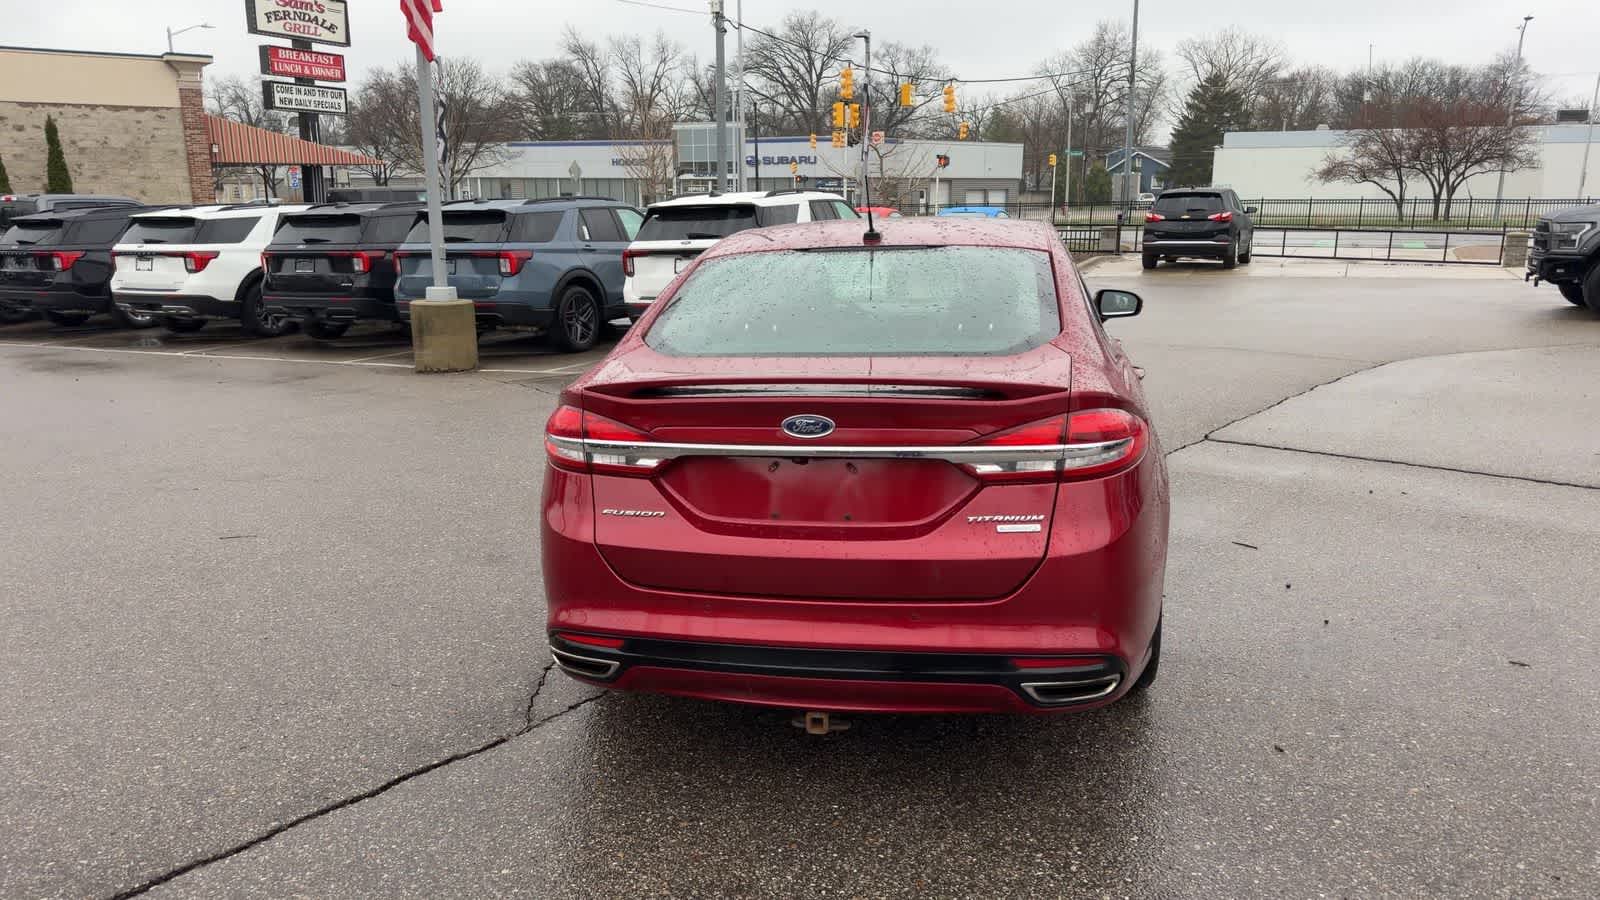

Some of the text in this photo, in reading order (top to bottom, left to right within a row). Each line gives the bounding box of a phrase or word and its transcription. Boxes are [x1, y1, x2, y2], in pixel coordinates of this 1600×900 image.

[264, 10, 338, 34] FERNDALE
[283, 22, 321, 37] GRILL
[278, 49, 335, 65] BREAKFAST
[274, 61, 342, 78] LUNCH & DINNER
[275, 85, 343, 100] COME IN AND TRY OUR
[279, 97, 342, 111] NEW DAILY SPECIALS
[762, 155, 817, 165] SUBARU
[792, 418, 824, 433] Ford
[967, 514, 1046, 523] TITANIUM
